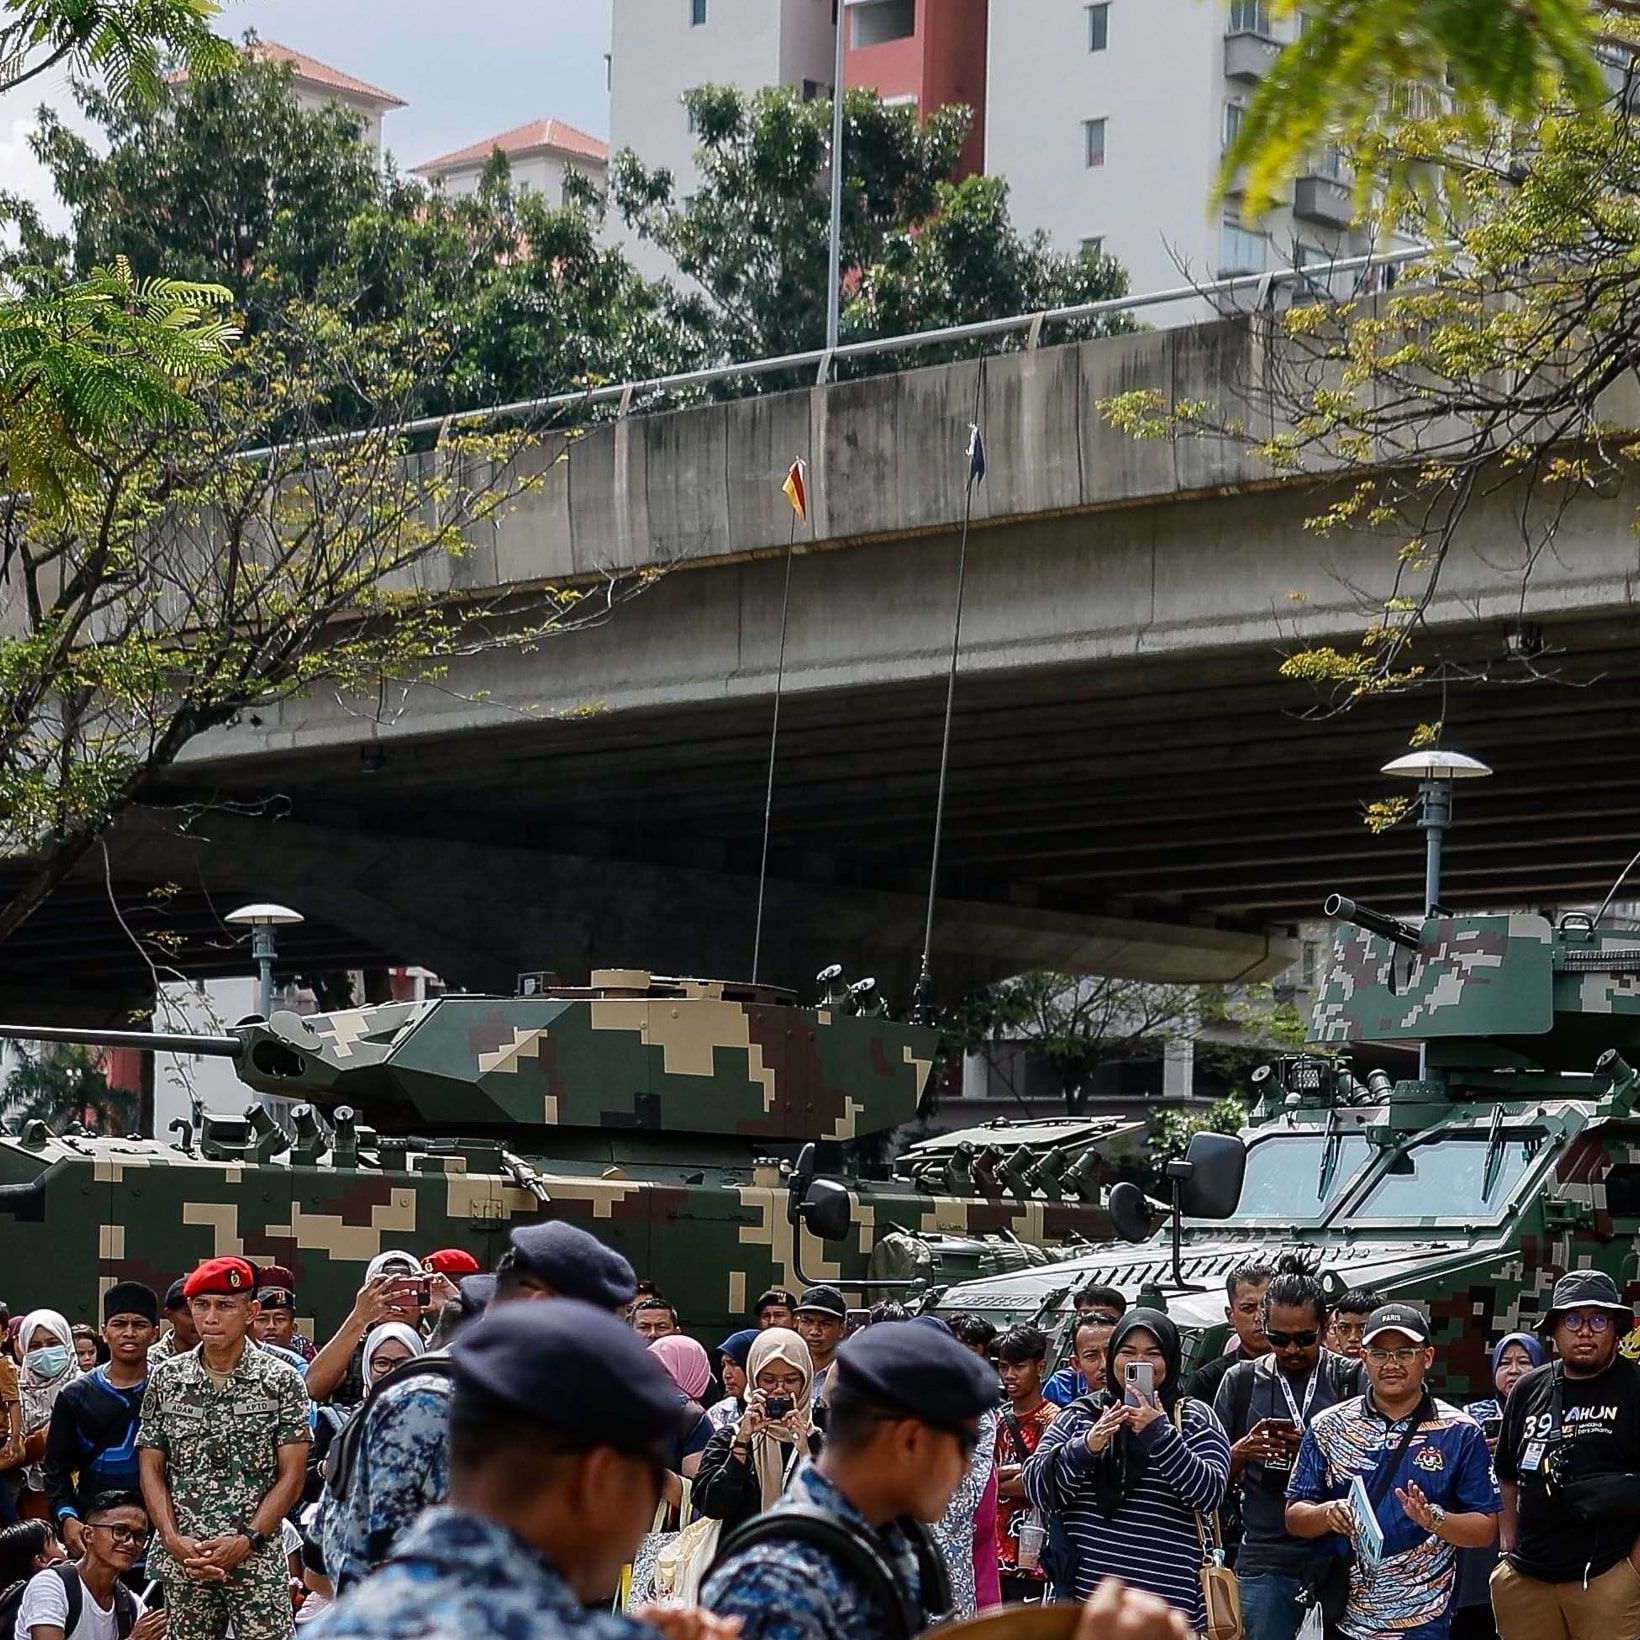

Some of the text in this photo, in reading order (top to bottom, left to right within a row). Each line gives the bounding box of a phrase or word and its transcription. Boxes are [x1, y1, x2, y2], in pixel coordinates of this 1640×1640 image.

[1382, 1314, 1401, 1322] PARIS
[171, 1405, 194, 1415] ADAM
[1523, 1405, 1618, 1439] 39 AHUN
